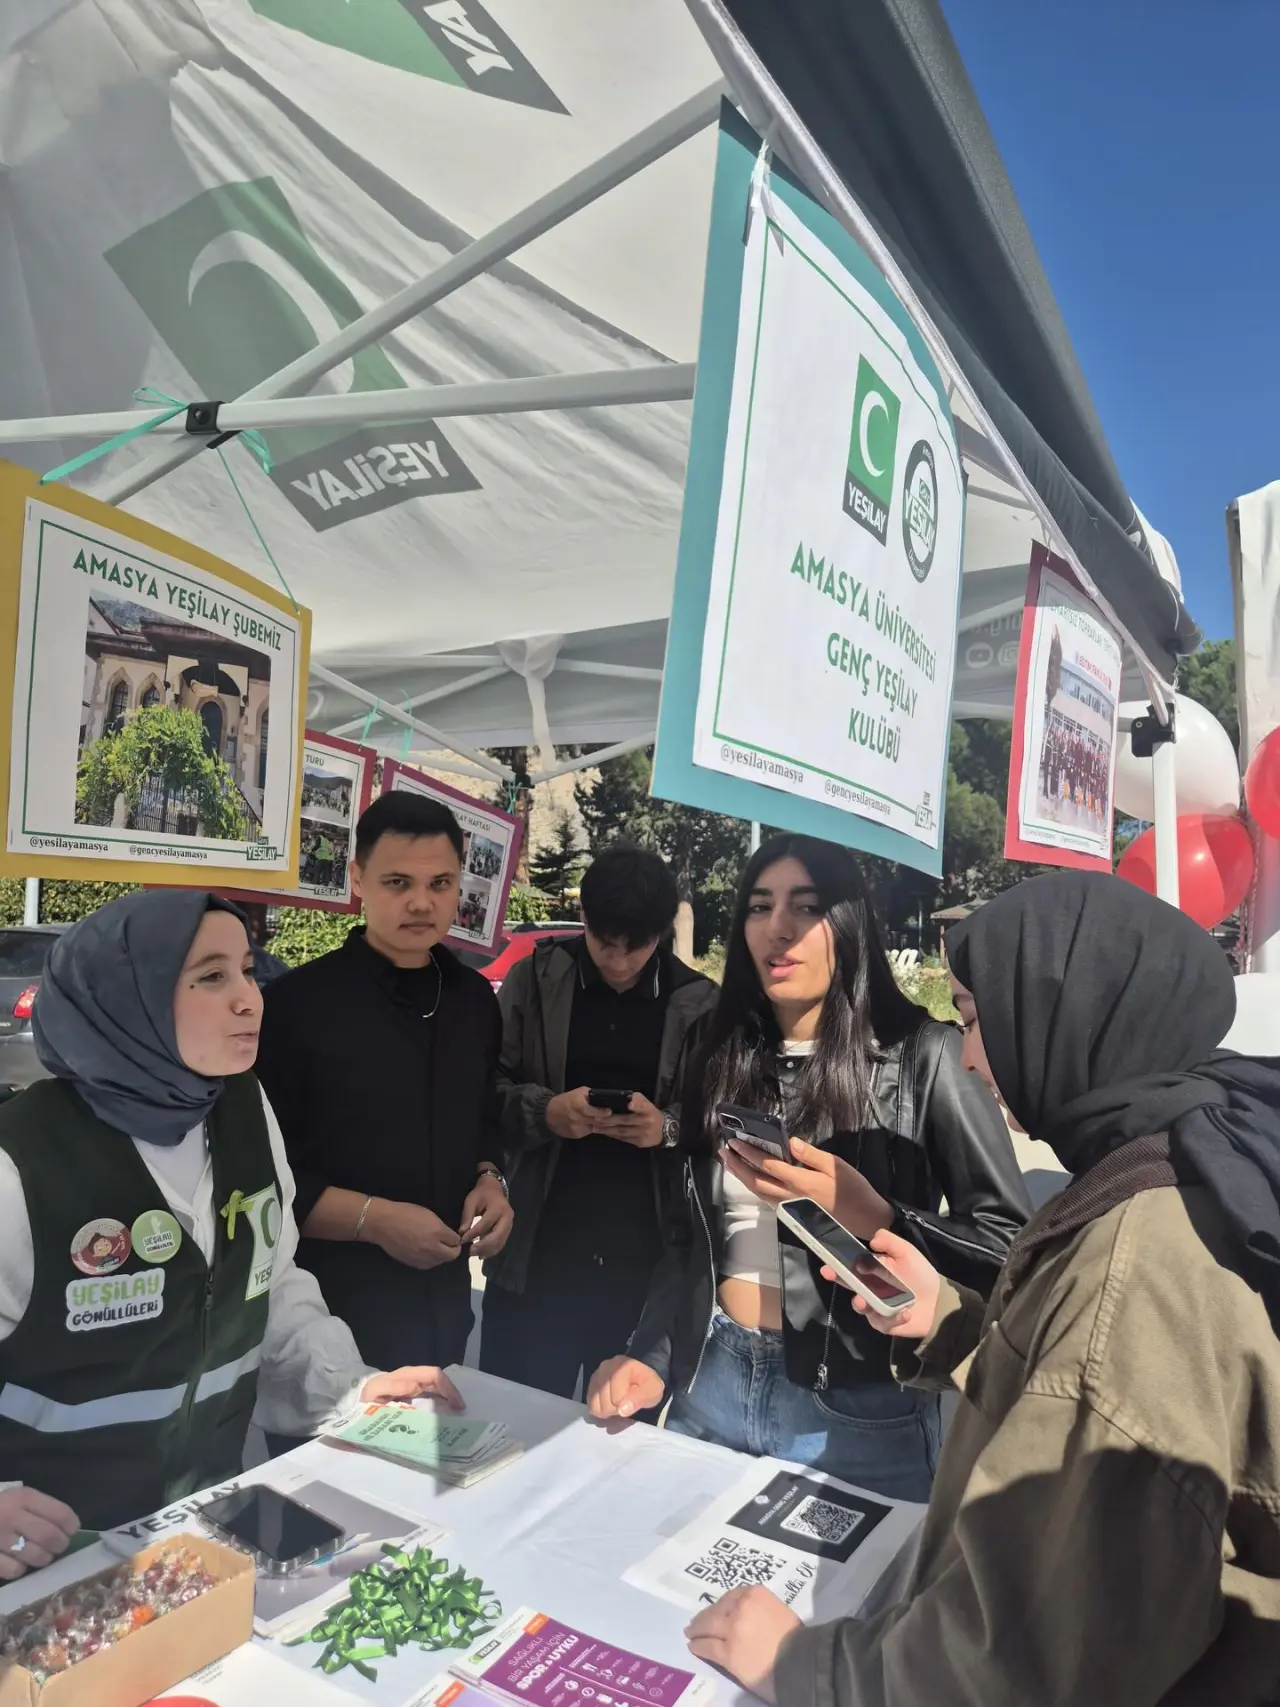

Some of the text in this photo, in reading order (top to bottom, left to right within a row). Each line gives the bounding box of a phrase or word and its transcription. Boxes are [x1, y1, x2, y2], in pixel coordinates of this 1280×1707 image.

[849, 482, 886, 534] YEŞİLAY
[72, 549, 281, 652] AMASYA YEŞİLAY ŞUBEMİZ
[790, 540, 937, 684] AMASYA ÜNİVERSİTESİ
[827, 632, 918, 719] GENÇ YEŞİLAY
[848, 707, 901, 764] KULÜBÜ
[721, 744, 804, 785] @yesilayamasya
[29, 836, 208, 860] @yesilayamasya @gencyesilayamasya
[72, 1274, 160, 1306] YEŞİLAY
[516, 1663, 549, 1690] SPOR
[548, 1634, 579, 1660] UYKU
